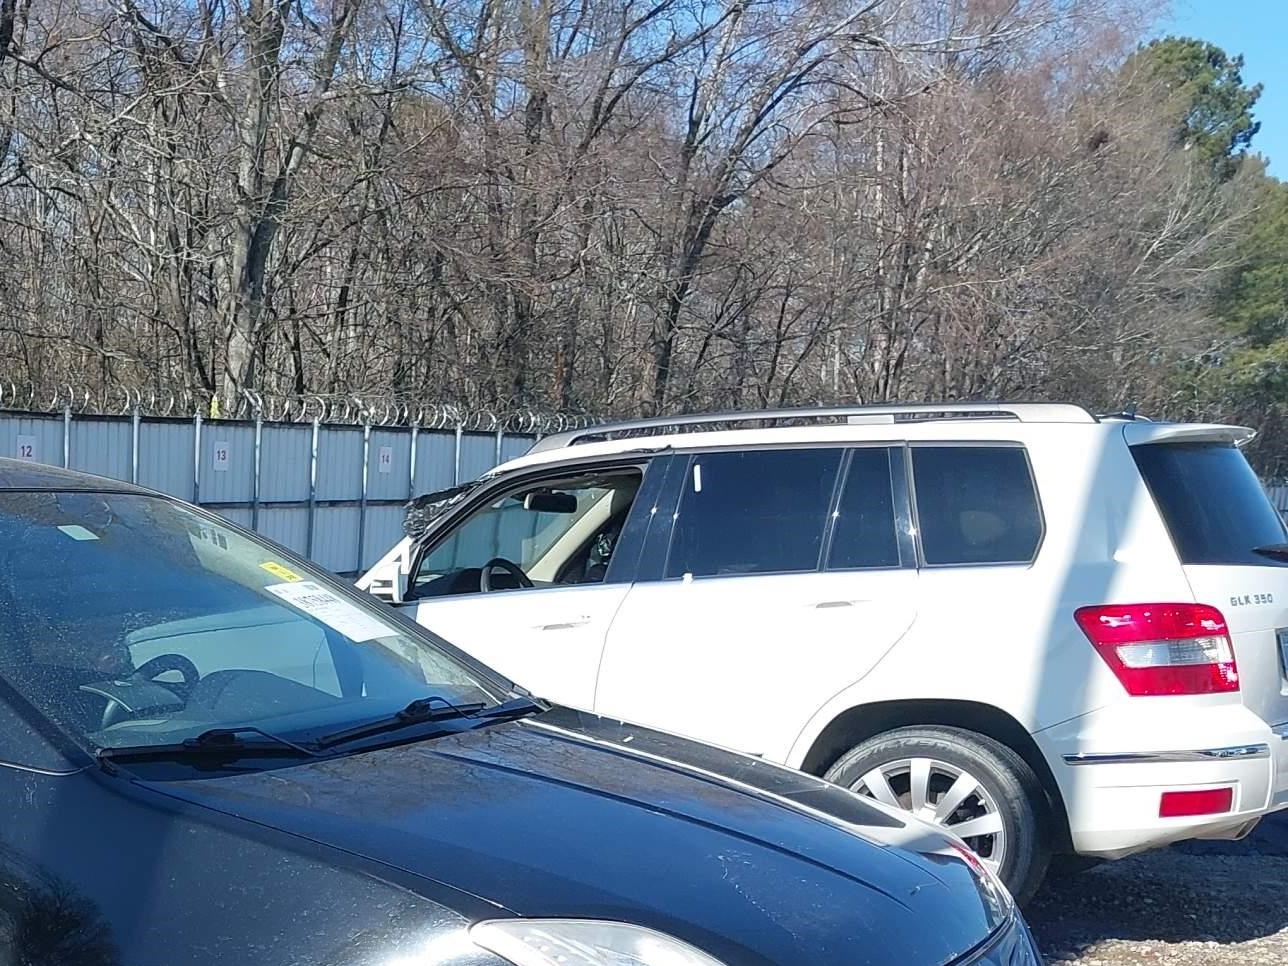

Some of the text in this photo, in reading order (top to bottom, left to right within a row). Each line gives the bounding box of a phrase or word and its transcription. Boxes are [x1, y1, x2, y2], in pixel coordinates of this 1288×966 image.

[21, 445, 33, 458] 12
[216, 450, 226, 461] 13
[1230, 593, 1273, 607] GLK 350
